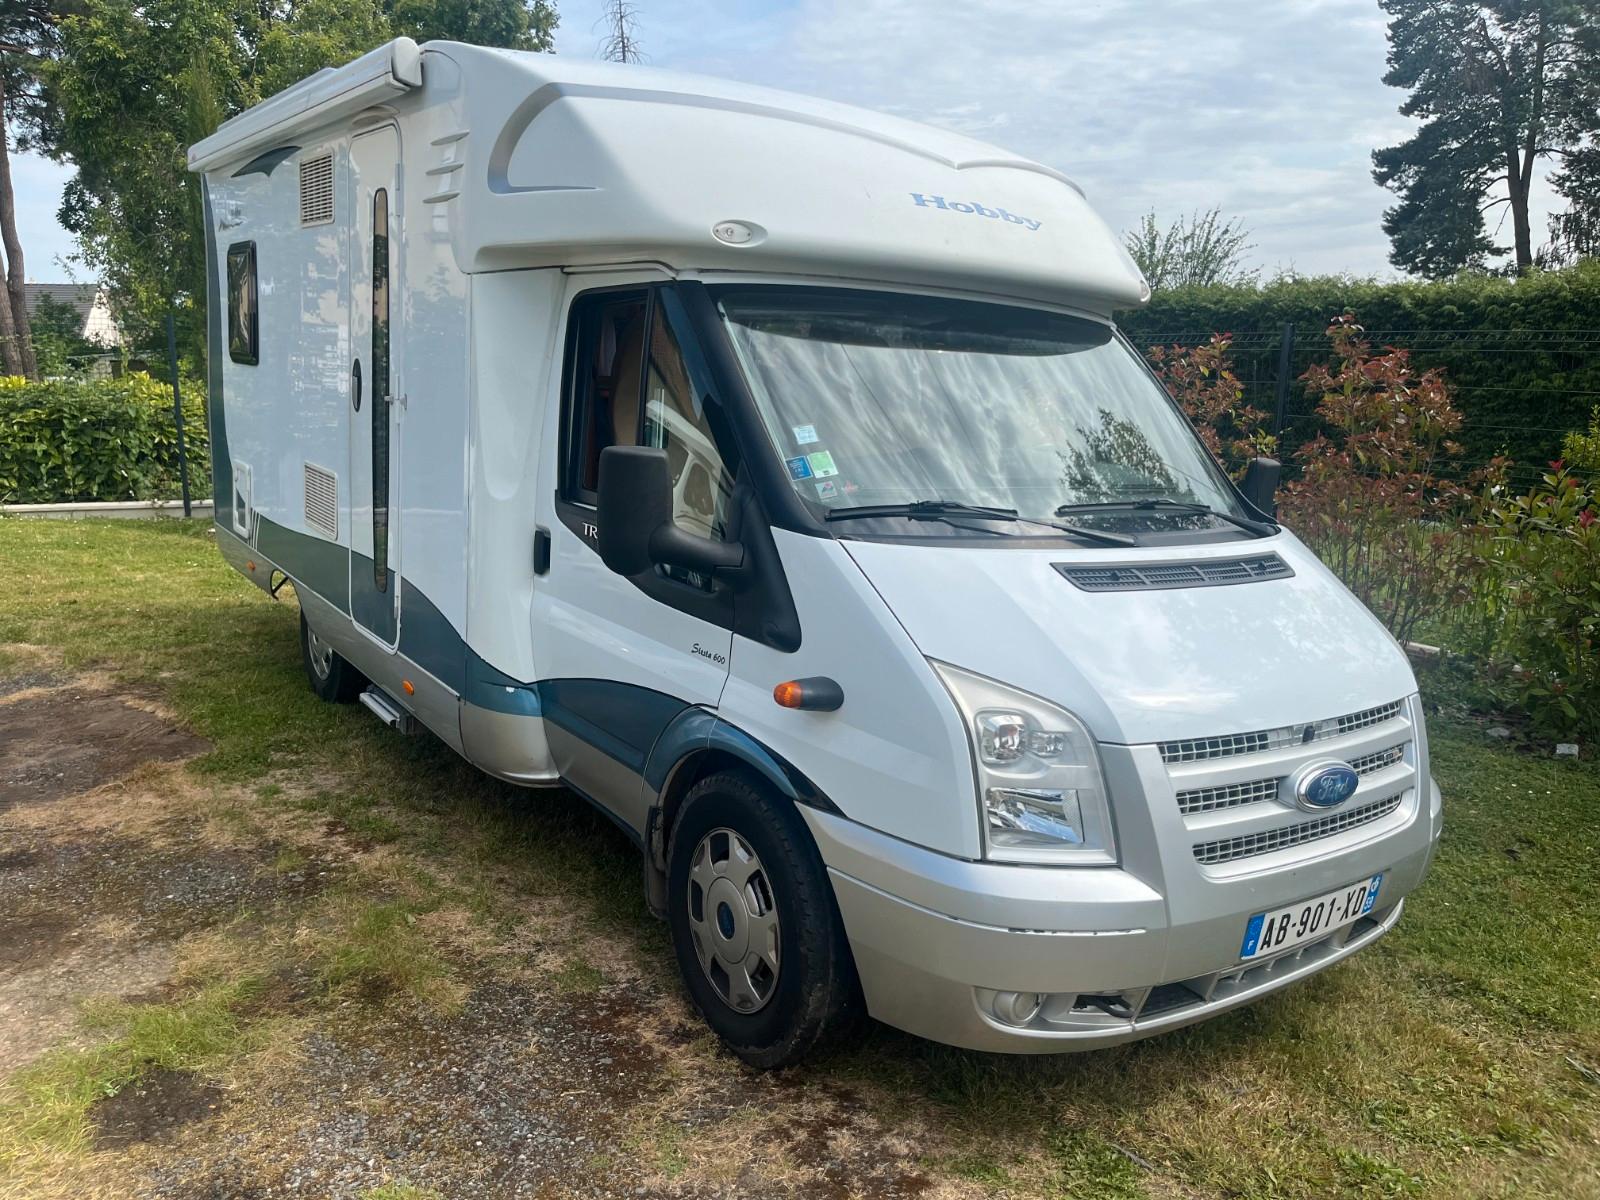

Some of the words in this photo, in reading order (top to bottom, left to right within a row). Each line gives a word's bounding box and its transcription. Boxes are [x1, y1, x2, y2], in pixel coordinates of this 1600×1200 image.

[909, 192, 1042, 231] Hobby
[713, 653, 726, 665] 600
[1318, 774, 1350, 801] Ford
[1247, 940, 1255, 950] F
[1260, 886, 1368, 951] AB-901-XD
